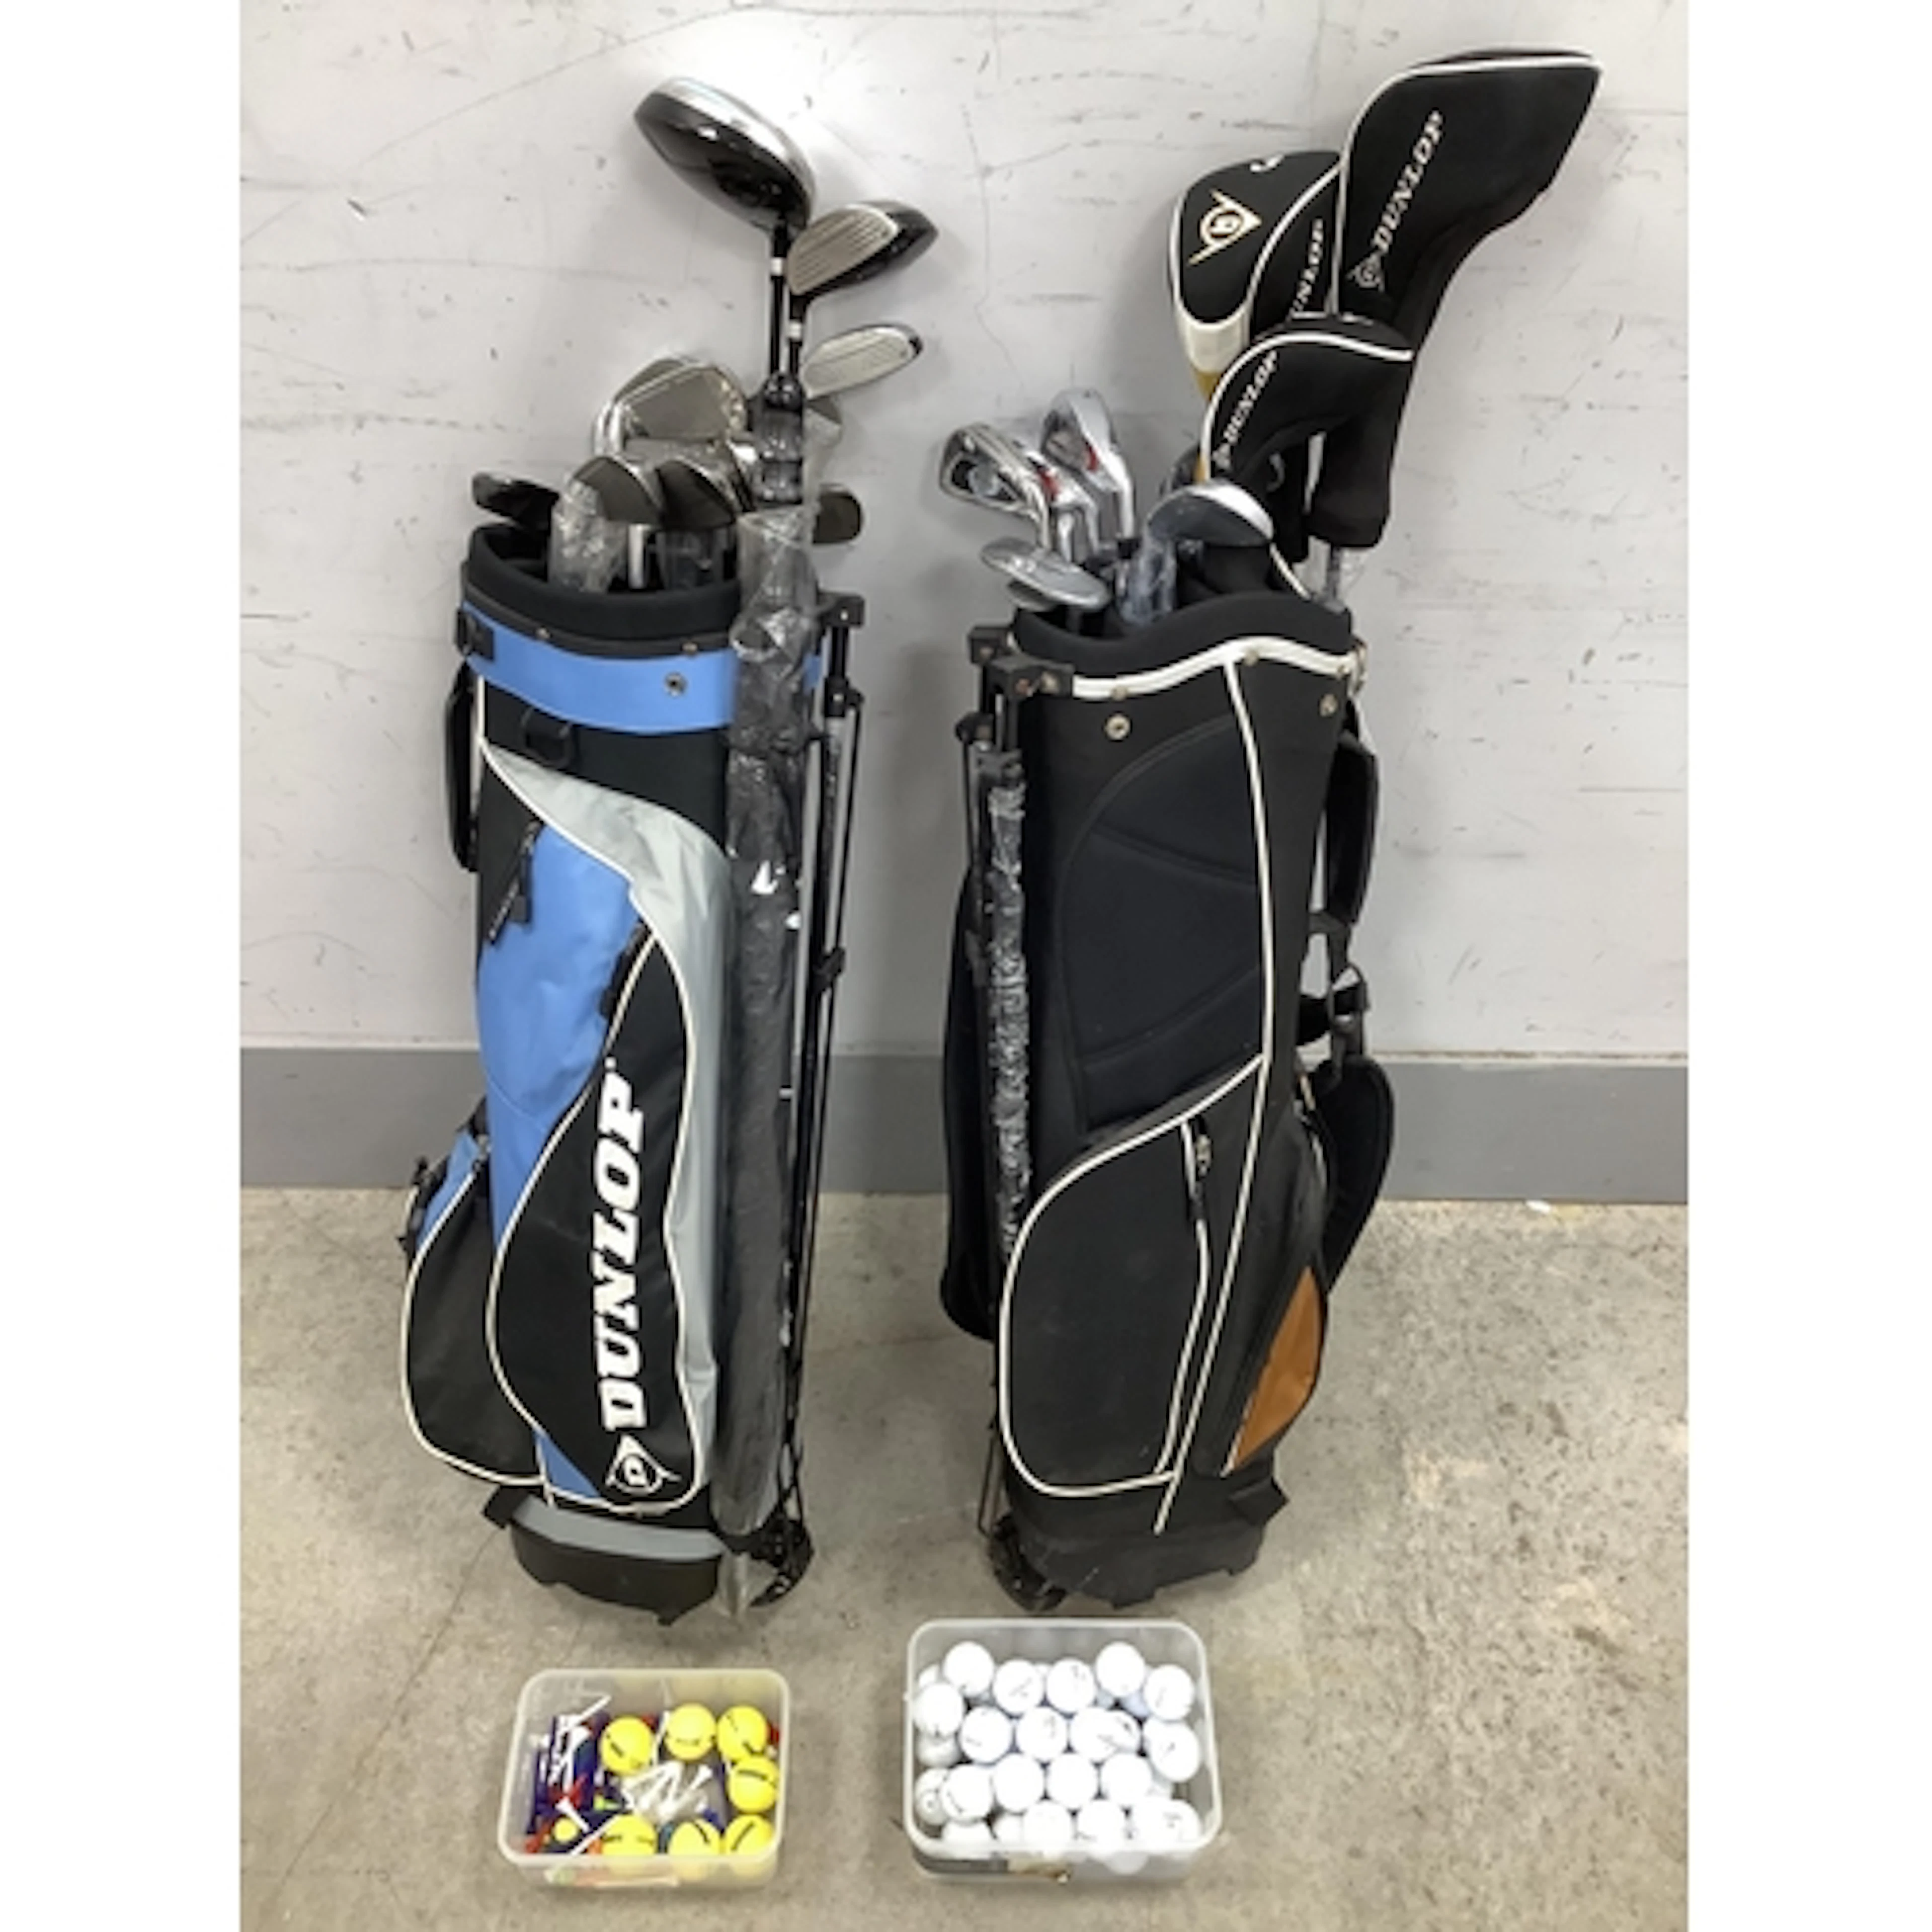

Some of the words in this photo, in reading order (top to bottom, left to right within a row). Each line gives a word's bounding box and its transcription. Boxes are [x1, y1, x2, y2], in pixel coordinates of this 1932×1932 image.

[1370, 110, 1442, 253] DUNLOP
[1223, 350, 1278, 444] DUNLOP
[591, 1072, 647, 1431] DUNLOP
